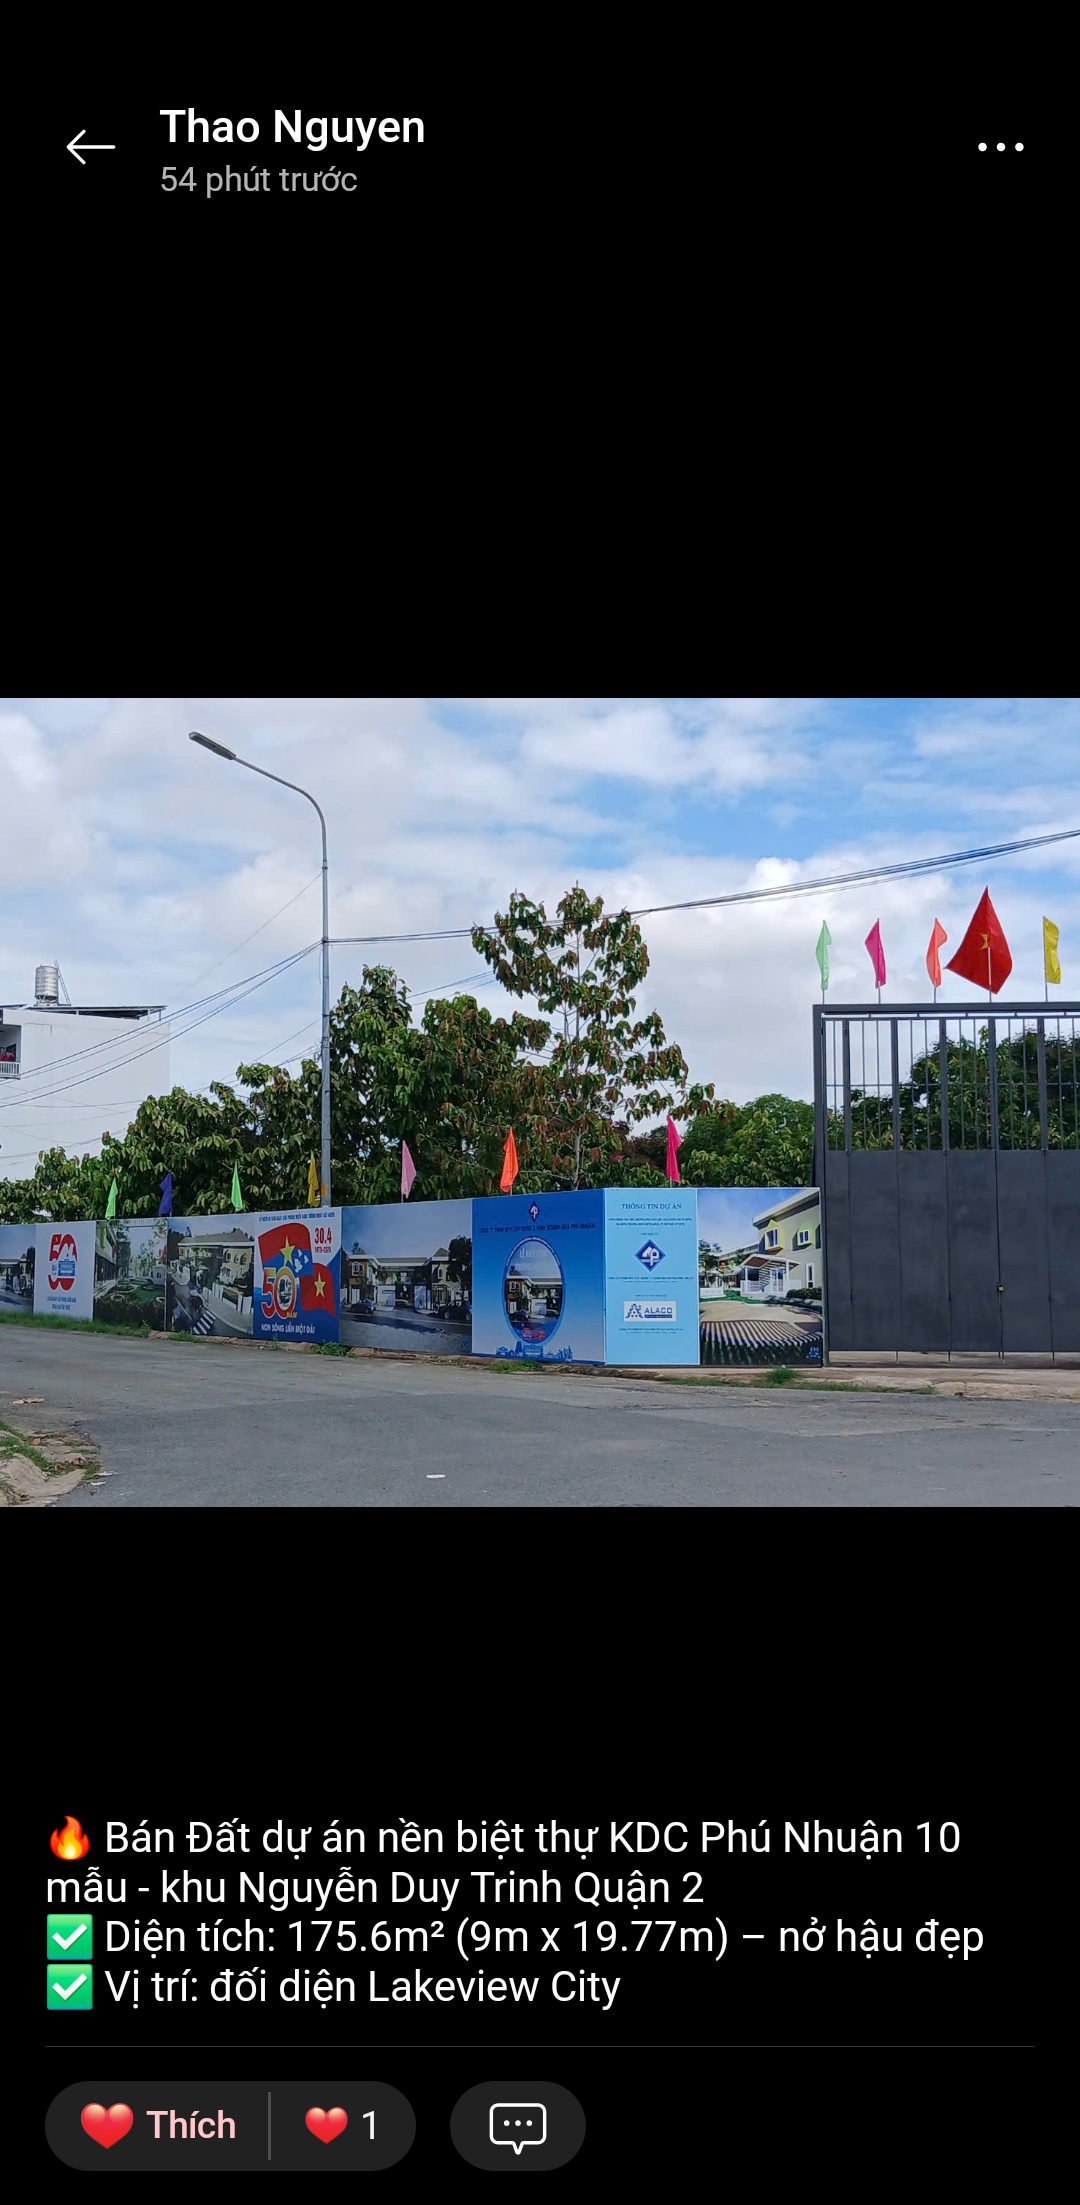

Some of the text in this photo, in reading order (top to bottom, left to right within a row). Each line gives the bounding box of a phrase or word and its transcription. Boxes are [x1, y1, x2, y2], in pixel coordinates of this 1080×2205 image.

[621, 1202, 646, 1210] THÔNG
[314, 1227, 332, 1244] 30.4
[261, 1266, 297, 1319] 50
